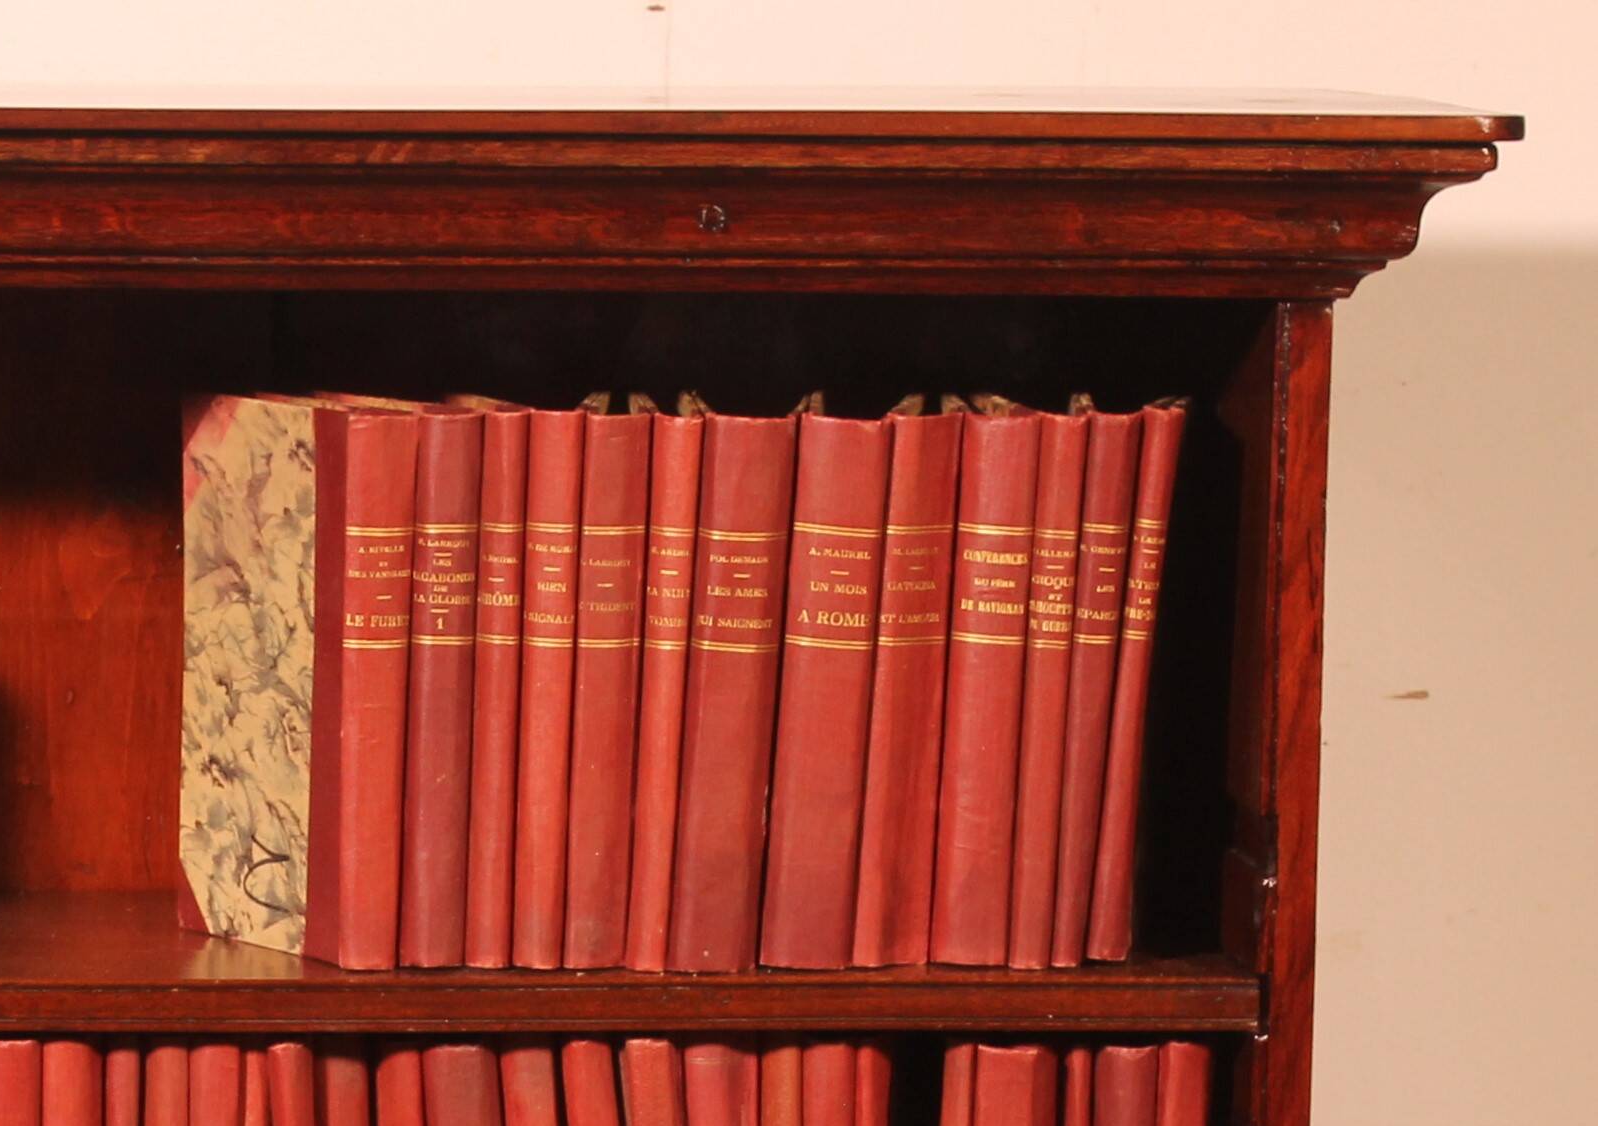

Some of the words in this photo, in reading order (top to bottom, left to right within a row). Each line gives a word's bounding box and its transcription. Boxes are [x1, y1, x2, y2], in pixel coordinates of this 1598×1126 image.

[707, 585, 732, 597] LES
[810, 578, 830, 592] UN
[833, 580, 868, 596] MOIS
[345, 613, 365, 628] LE
[796, 607, 810, 624] A
[435, 616, 445, 631] 1
